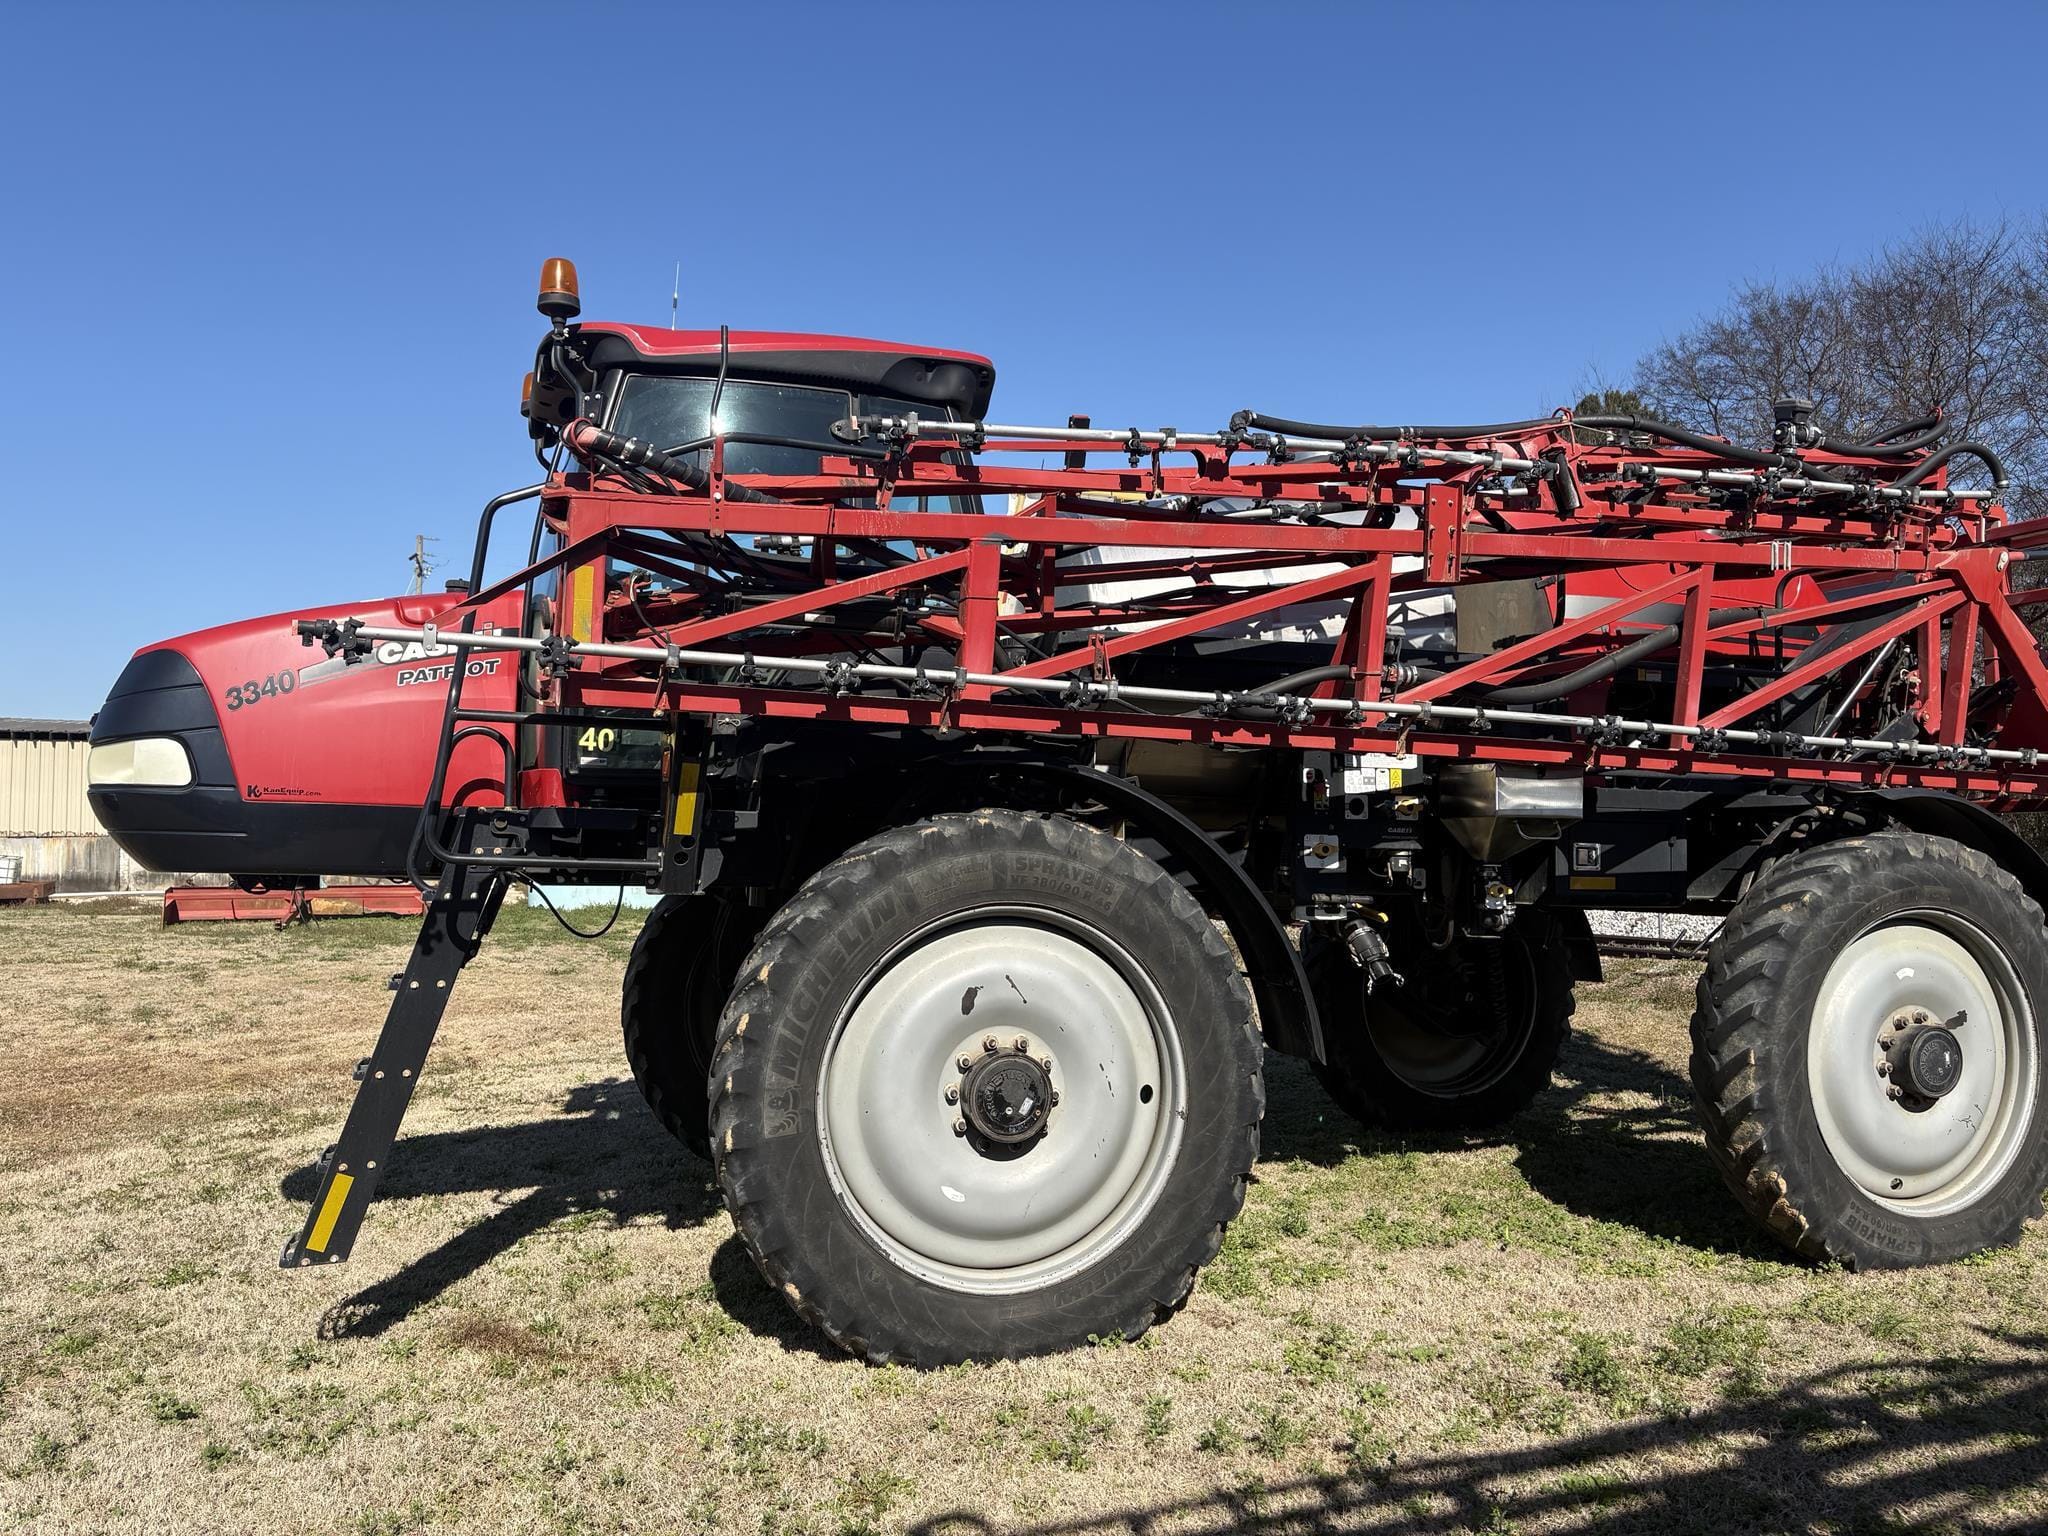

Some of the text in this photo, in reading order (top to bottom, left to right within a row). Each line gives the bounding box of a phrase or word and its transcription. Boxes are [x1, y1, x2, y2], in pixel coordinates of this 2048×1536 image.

[398, 659, 501, 686] PATROT
[225, 671, 295, 711] 3340
[578, 727, 614, 752] 40
[263, 786, 322, 797] KanEquip.com
[1014, 855, 1114, 896] SPRAYBIB
[1032, 875, 1081, 896] 380/90
[768, 886, 899, 1084] MICHELIN
[1845, 1214, 1917, 1251] SPRAYBIB
